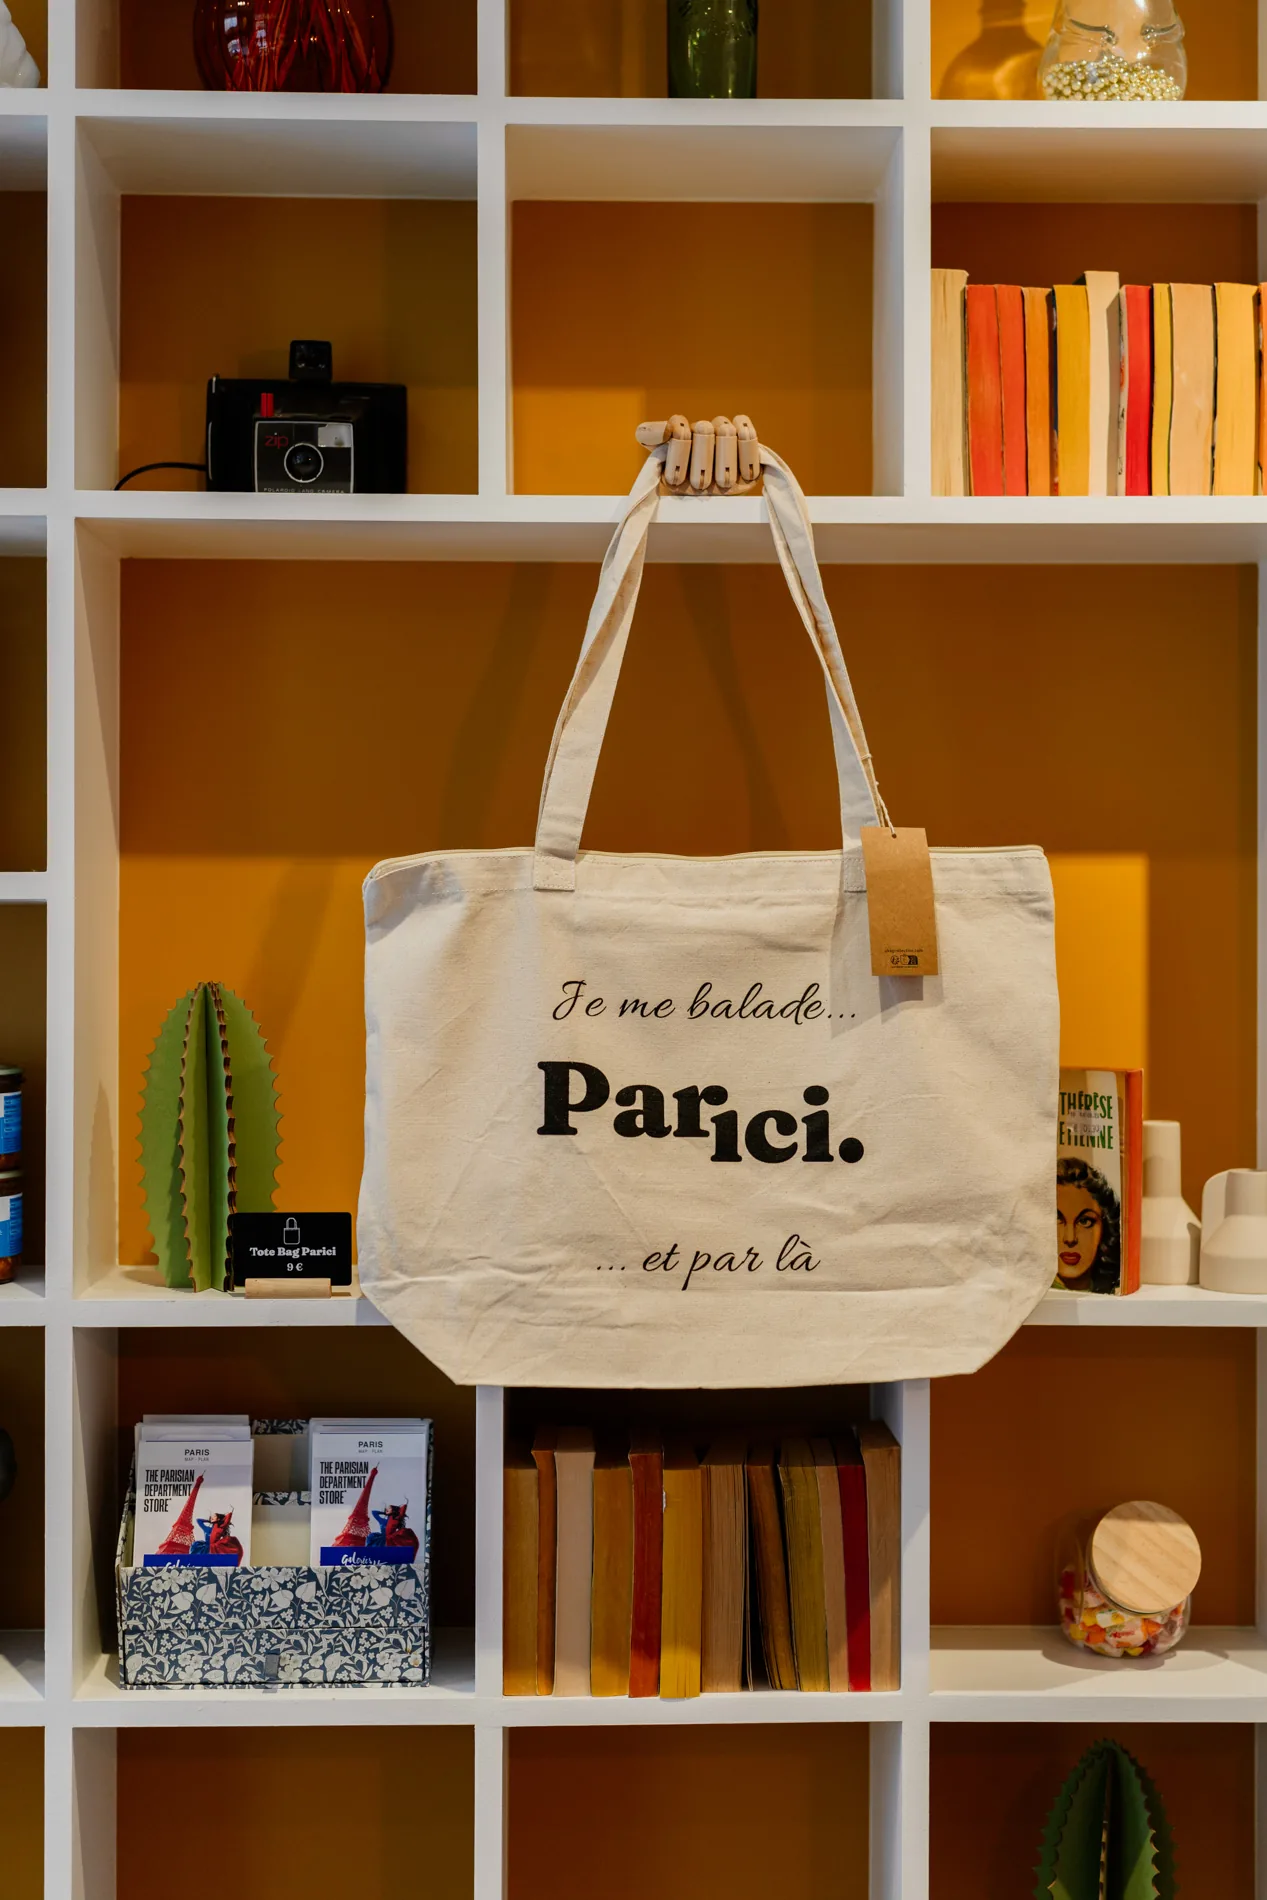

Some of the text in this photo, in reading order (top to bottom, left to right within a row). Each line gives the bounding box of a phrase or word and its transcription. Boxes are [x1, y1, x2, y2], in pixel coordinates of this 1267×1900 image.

[264, 432, 289, 449] zip
[552, 979, 857, 1025] Je me balade...
[537, 1060, 865, 1164] Parici.
[249, 1246, 337, 1259] Tote Bag Parici
[286, 1262, 304, 1272] 9 €
[642, 1243, 682, 1272] et
[682, 1253, 764, 1291] par
[776, 1234, 822, 1272] là
[320, 1461, 369, 1474] THE PARISIAN
[145, 1469, 195, 1482] THE PARISIAN
[319, 1476, 367, 1489] DEPARTMENT
[144, 1484, 193, 1497] DEPARTMENT
